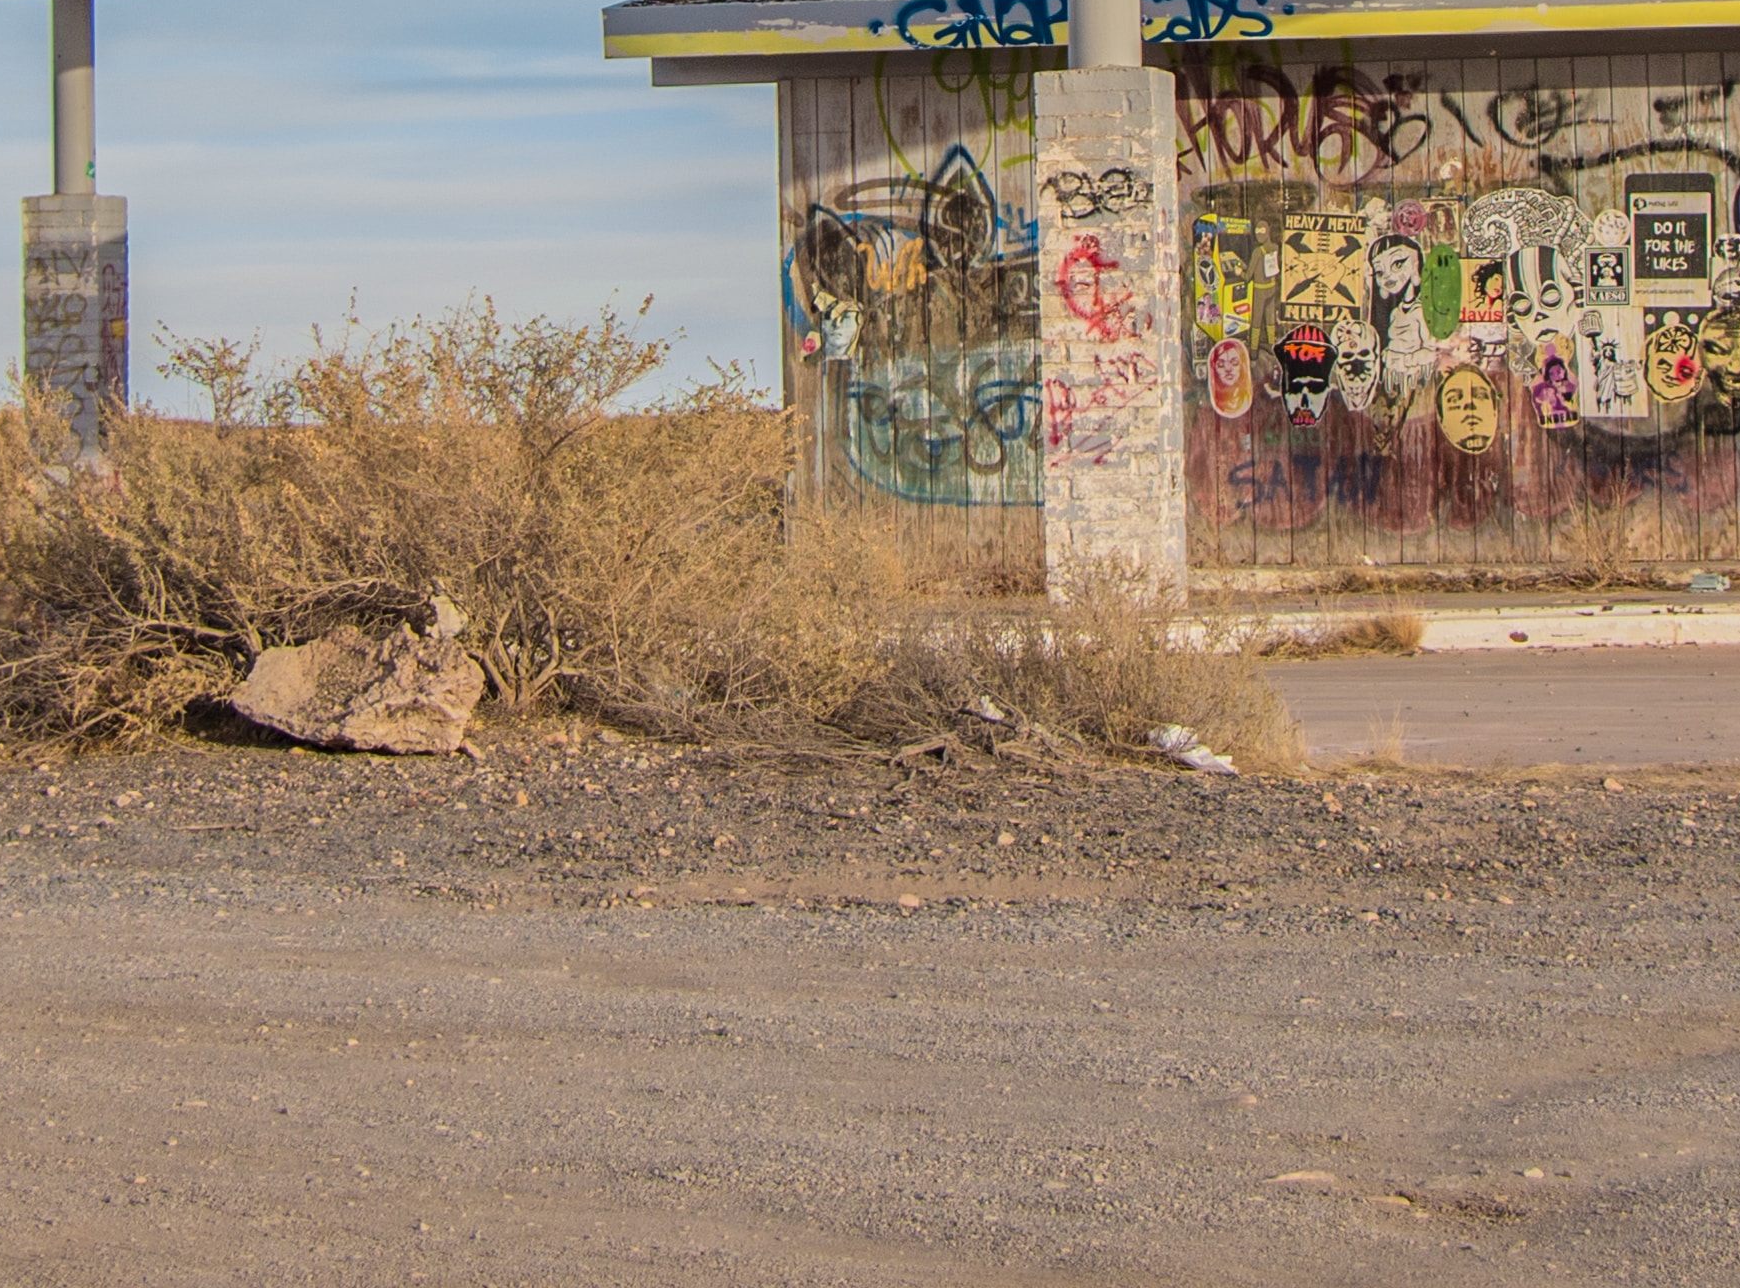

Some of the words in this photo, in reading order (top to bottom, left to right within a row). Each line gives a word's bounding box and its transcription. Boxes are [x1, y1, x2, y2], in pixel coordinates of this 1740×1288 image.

[1285, 215, 1325, 230] HEAVY
[1328, 217, 1366, 232] METAL
[1653, 221, 1672, 235] DO
[1676, 220, 1687, 237] IT
[1644, 239, 1670, 253] FOR
[1653, 257, 1688, 271] LIKES
[1285, 305, 1353, 321] NINJA
[1460, 306, 1504, 322] davis
[1540, 411, 1579, 426] UNDEAD
[1228, 452, 1383, 508] SATAN
